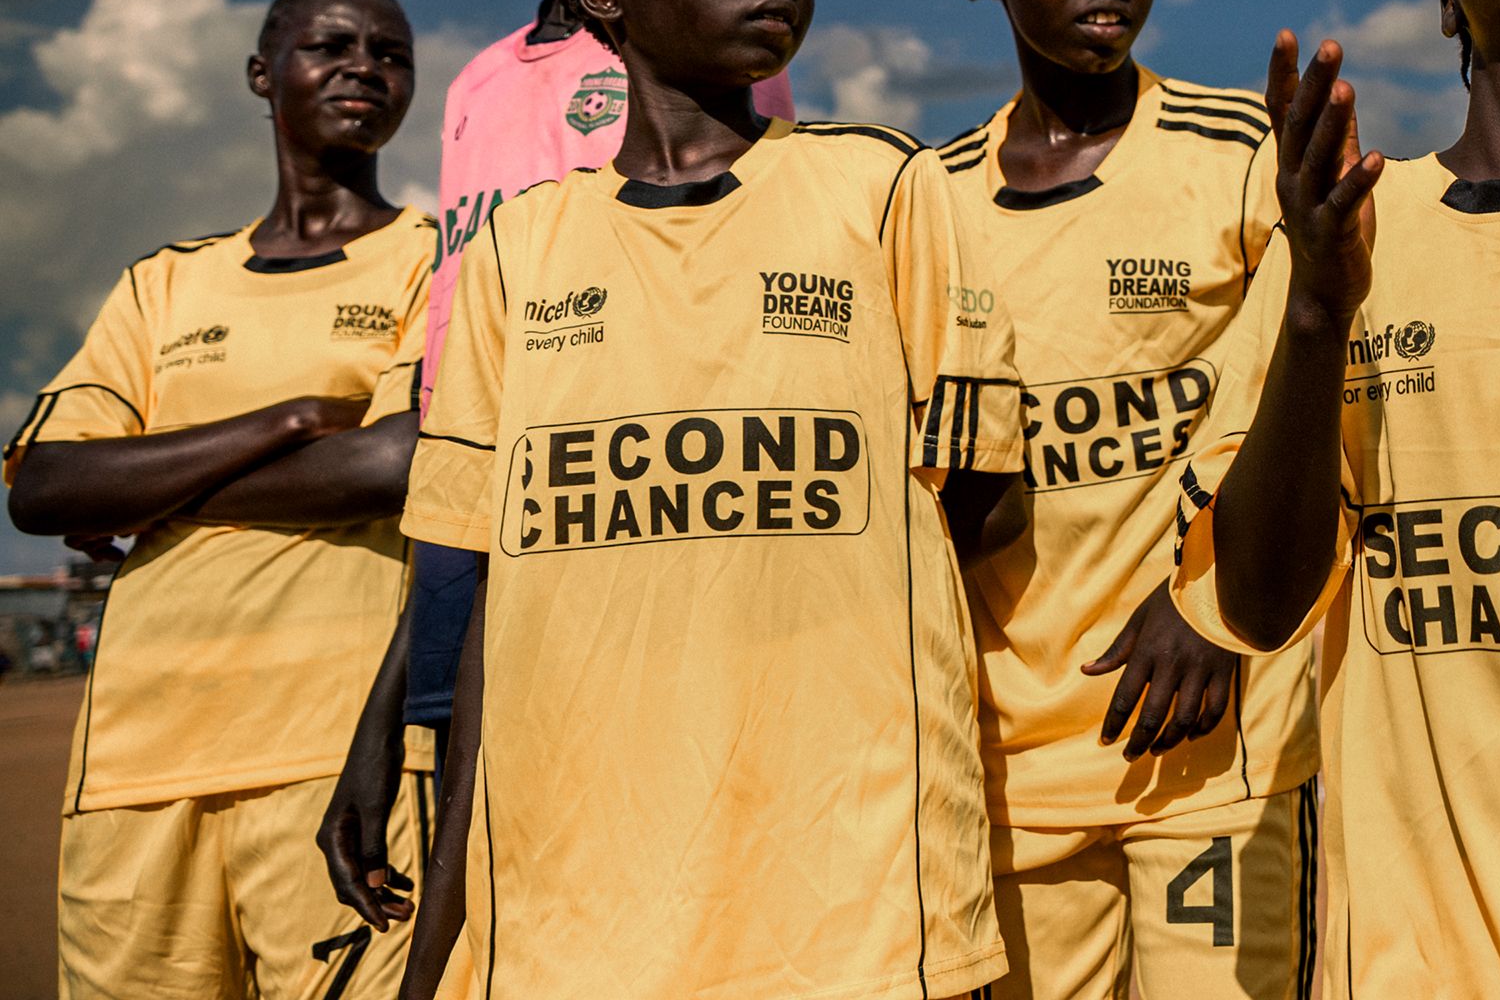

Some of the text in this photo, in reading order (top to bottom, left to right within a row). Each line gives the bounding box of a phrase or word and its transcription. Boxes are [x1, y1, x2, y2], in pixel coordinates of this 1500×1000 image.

[1106, 259, 1191, 277] YOUNG
[759, 272, 853, 301] YOUNG
[1110, 278, 1190, 296] DREAMS
[337, 304, 394, 319] YOUN
[763, 294, 852, 323] DREAMS
[1109, 297, 1187, 309] FOUNDATION
[763, 316, 848, 337] FOUNDATION
[526, 326, 604, 352] every child
[1346, 324, 1394, 366] nicef
[1397, 372, 1434, 395] child
[521, 479, 842, 549] CHANCES
[1166, 836, 1234, 946] 4
